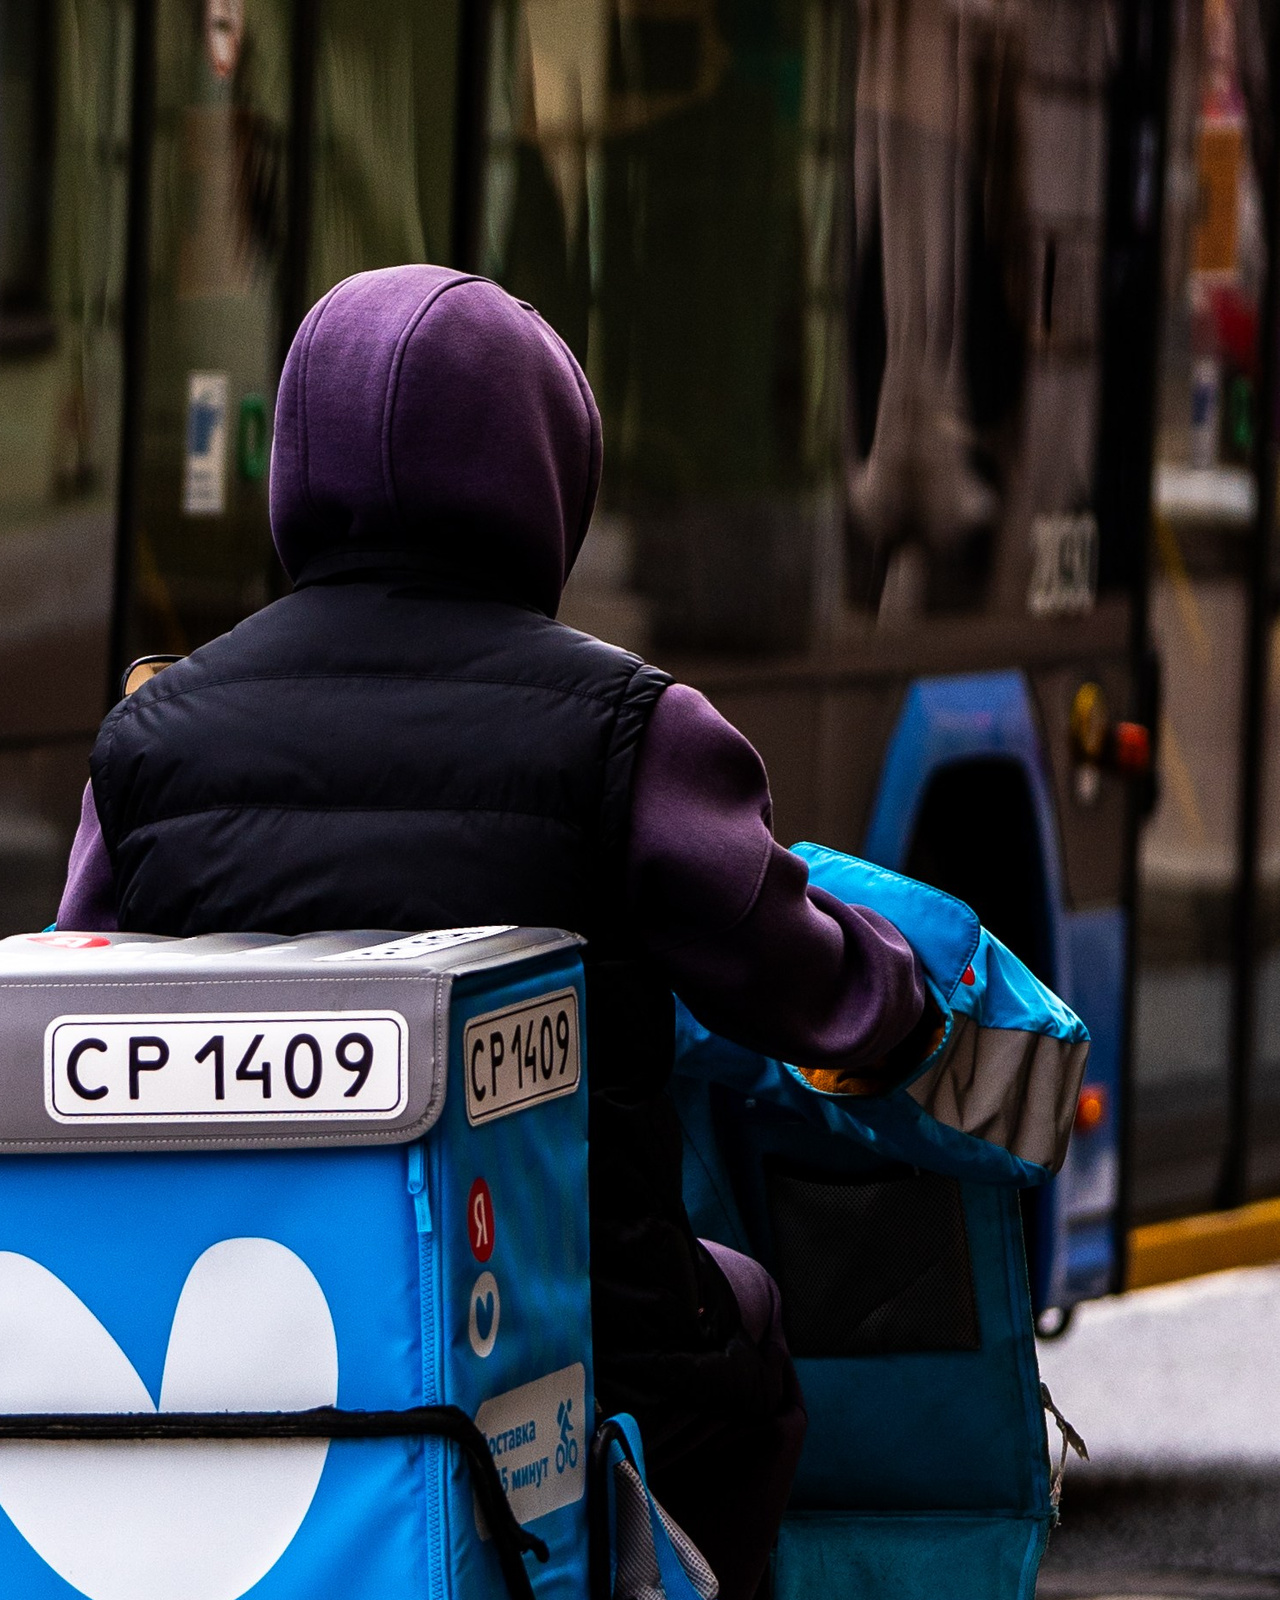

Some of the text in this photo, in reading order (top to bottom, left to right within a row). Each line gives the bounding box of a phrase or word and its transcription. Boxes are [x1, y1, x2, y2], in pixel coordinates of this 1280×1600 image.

[66, 1031, 374, 1101] СР 1409
[471, 1009, 570, 1102] СР 1409
[474, 1192, 488, 1249] Я
[483, 1420, 537, 1456] оставка
[511, 1456, 549, 1492] минут
